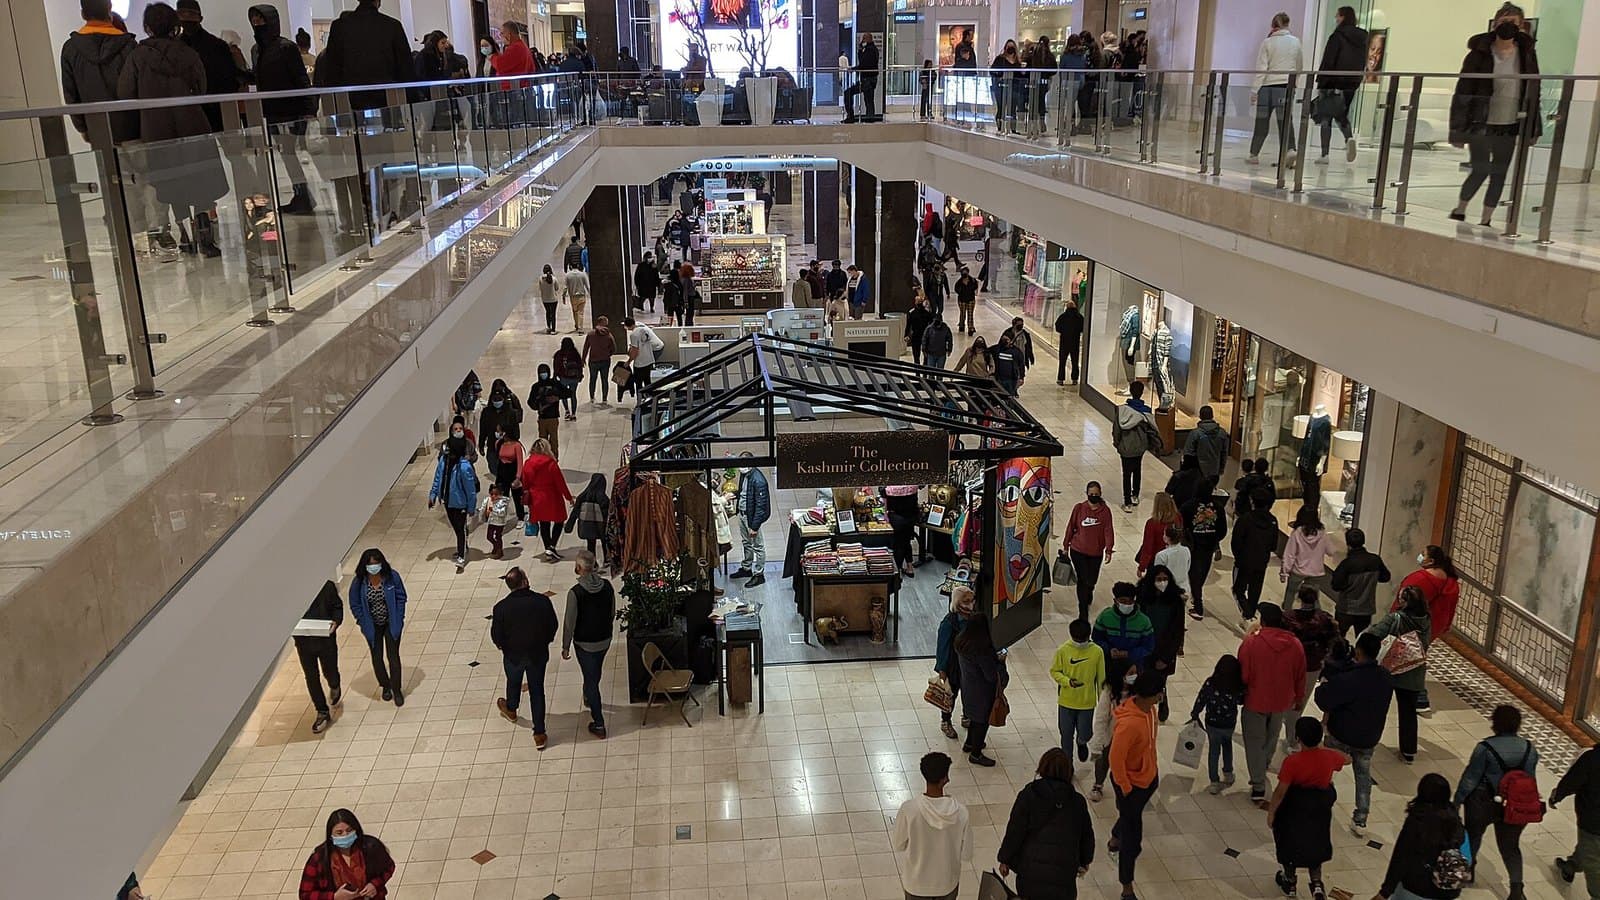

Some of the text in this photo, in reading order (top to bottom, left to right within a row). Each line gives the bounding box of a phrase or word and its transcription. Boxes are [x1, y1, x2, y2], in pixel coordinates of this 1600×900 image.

[850, 445, 879, 458] The
[796, 458, 929, 474] Kashmir Collection
